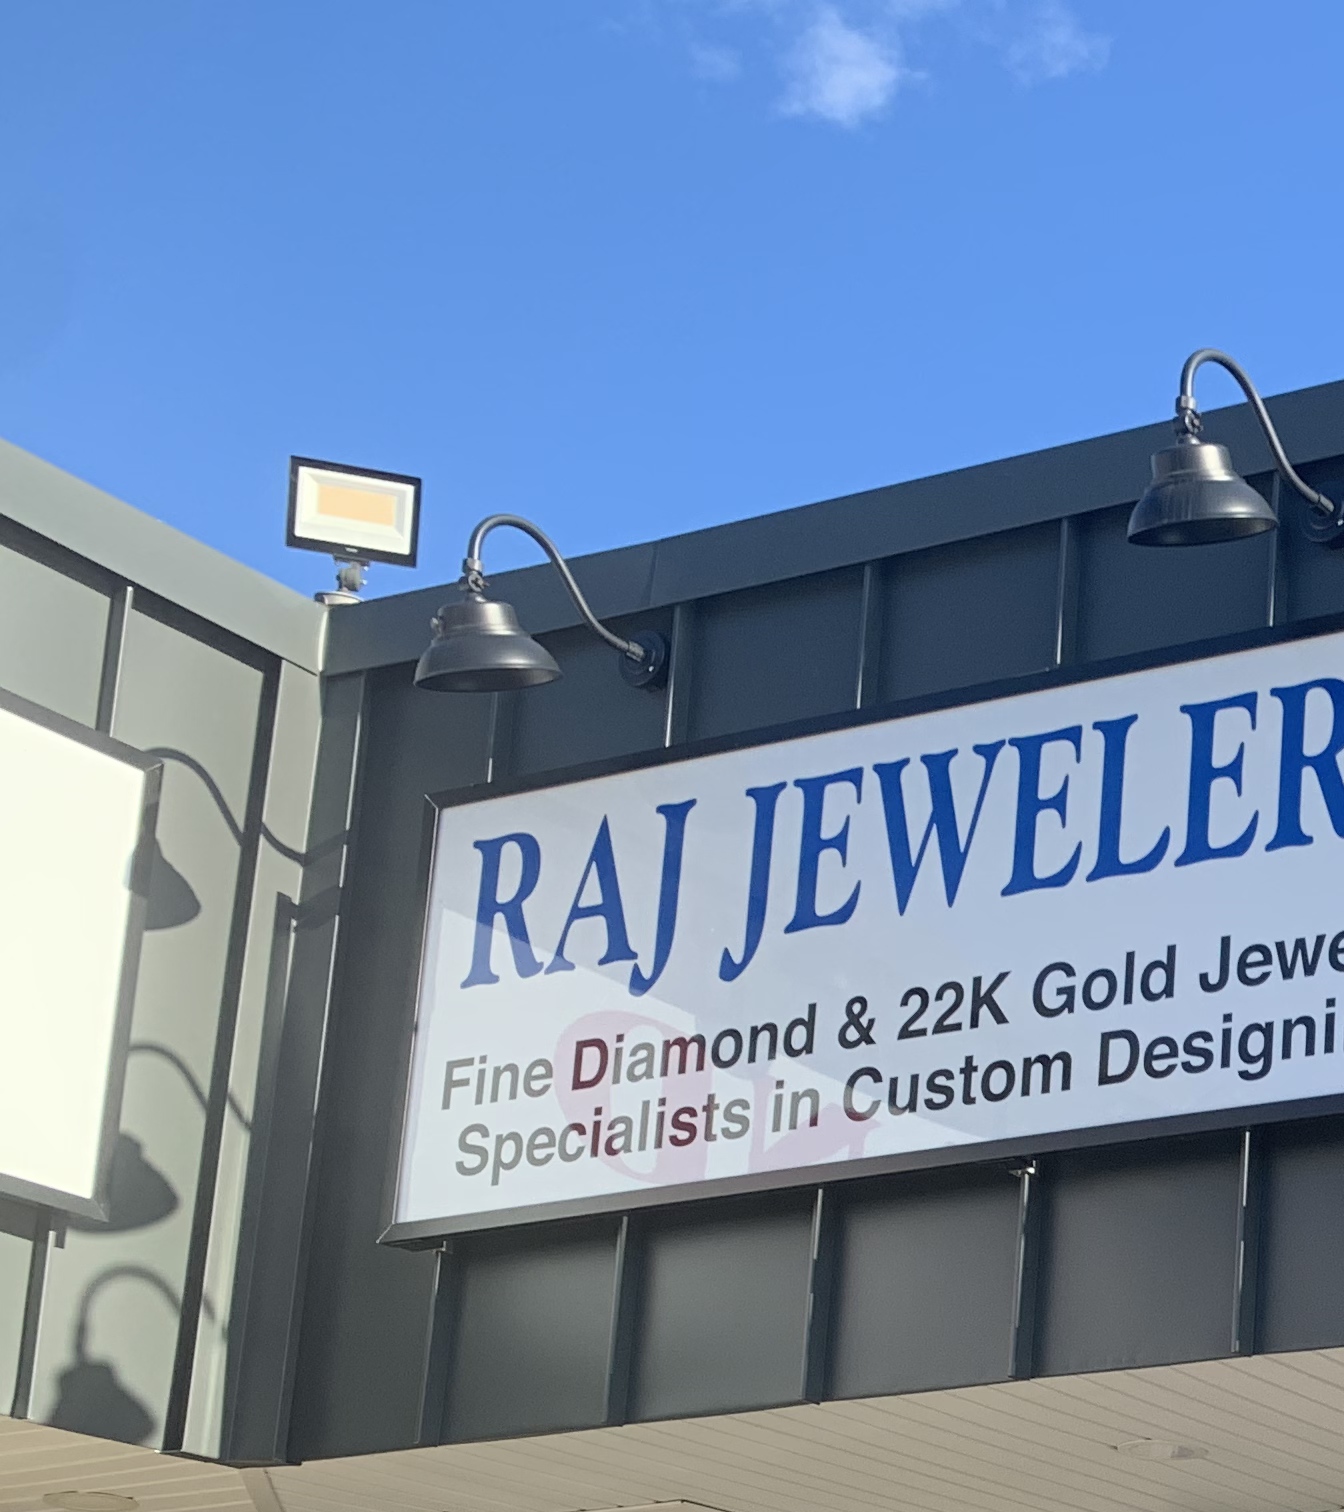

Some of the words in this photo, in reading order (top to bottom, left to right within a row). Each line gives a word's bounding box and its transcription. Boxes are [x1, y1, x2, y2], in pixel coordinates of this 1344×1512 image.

[464, 799, 696, 995] RAJ
[441, 1055, 553, 1111] Fine
[571, 1002, 818, 1092] Diamond
[838, 995, 876, 1050] &
[897, 971, 1012, 1041] 22K
[1031, 944, 1178, 1017] Gold
[455, 1094, 751, 1186] Specialists
[771, 1080, 819, 1133] in
[843, 1049, 1073, 1122] Custom
